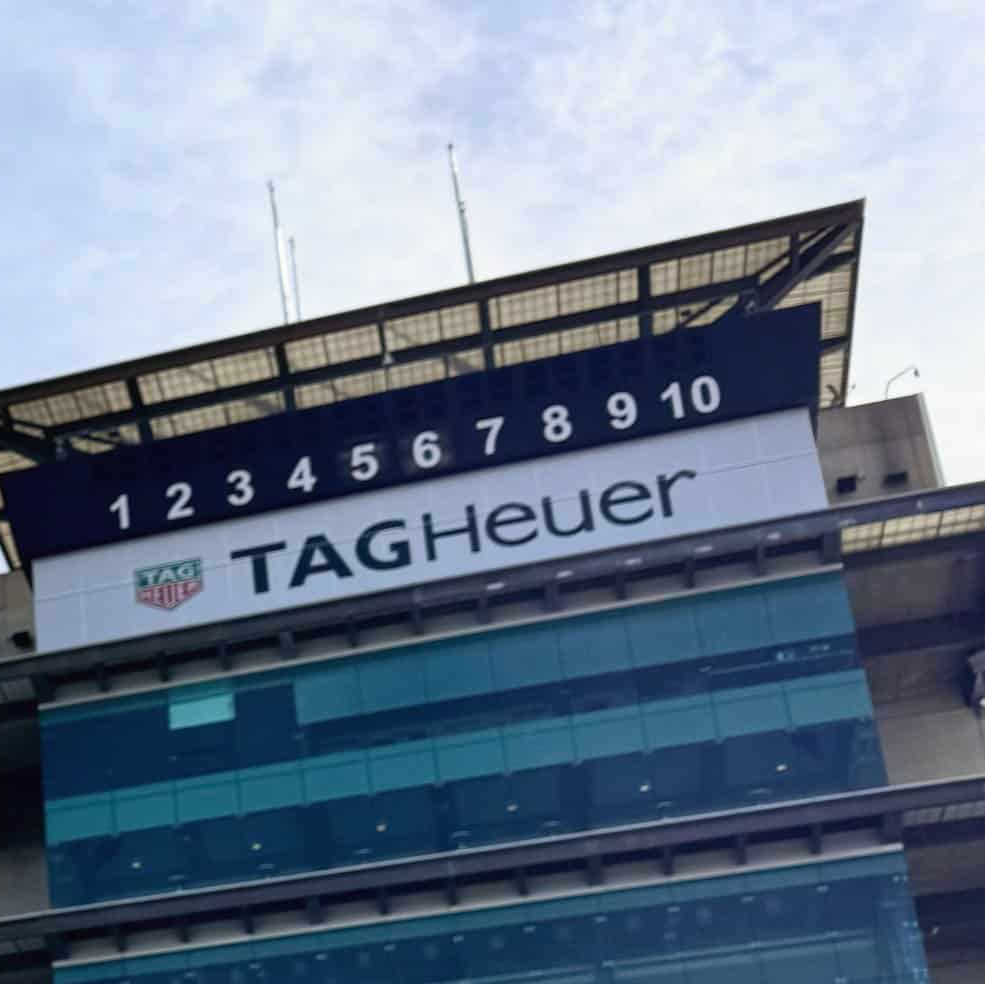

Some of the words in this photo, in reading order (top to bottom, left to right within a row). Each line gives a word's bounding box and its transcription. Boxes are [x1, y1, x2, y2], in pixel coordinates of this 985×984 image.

[110, 495, 129, 529] 1
[166, 483, 193, 519] 2
[227, 470, 253, 505] 3
[287, 457, 316, 492] 4
[351, 443, 379, 481] 5
[413, 431, 441, 468] 6
[476, 417, 504, 455] 7
[543, 405, 572, 442] 8
[607, 392, 637, 429] 9
[661, 376, 720, 419] 10
[138, 562, 196, 586] TAG
